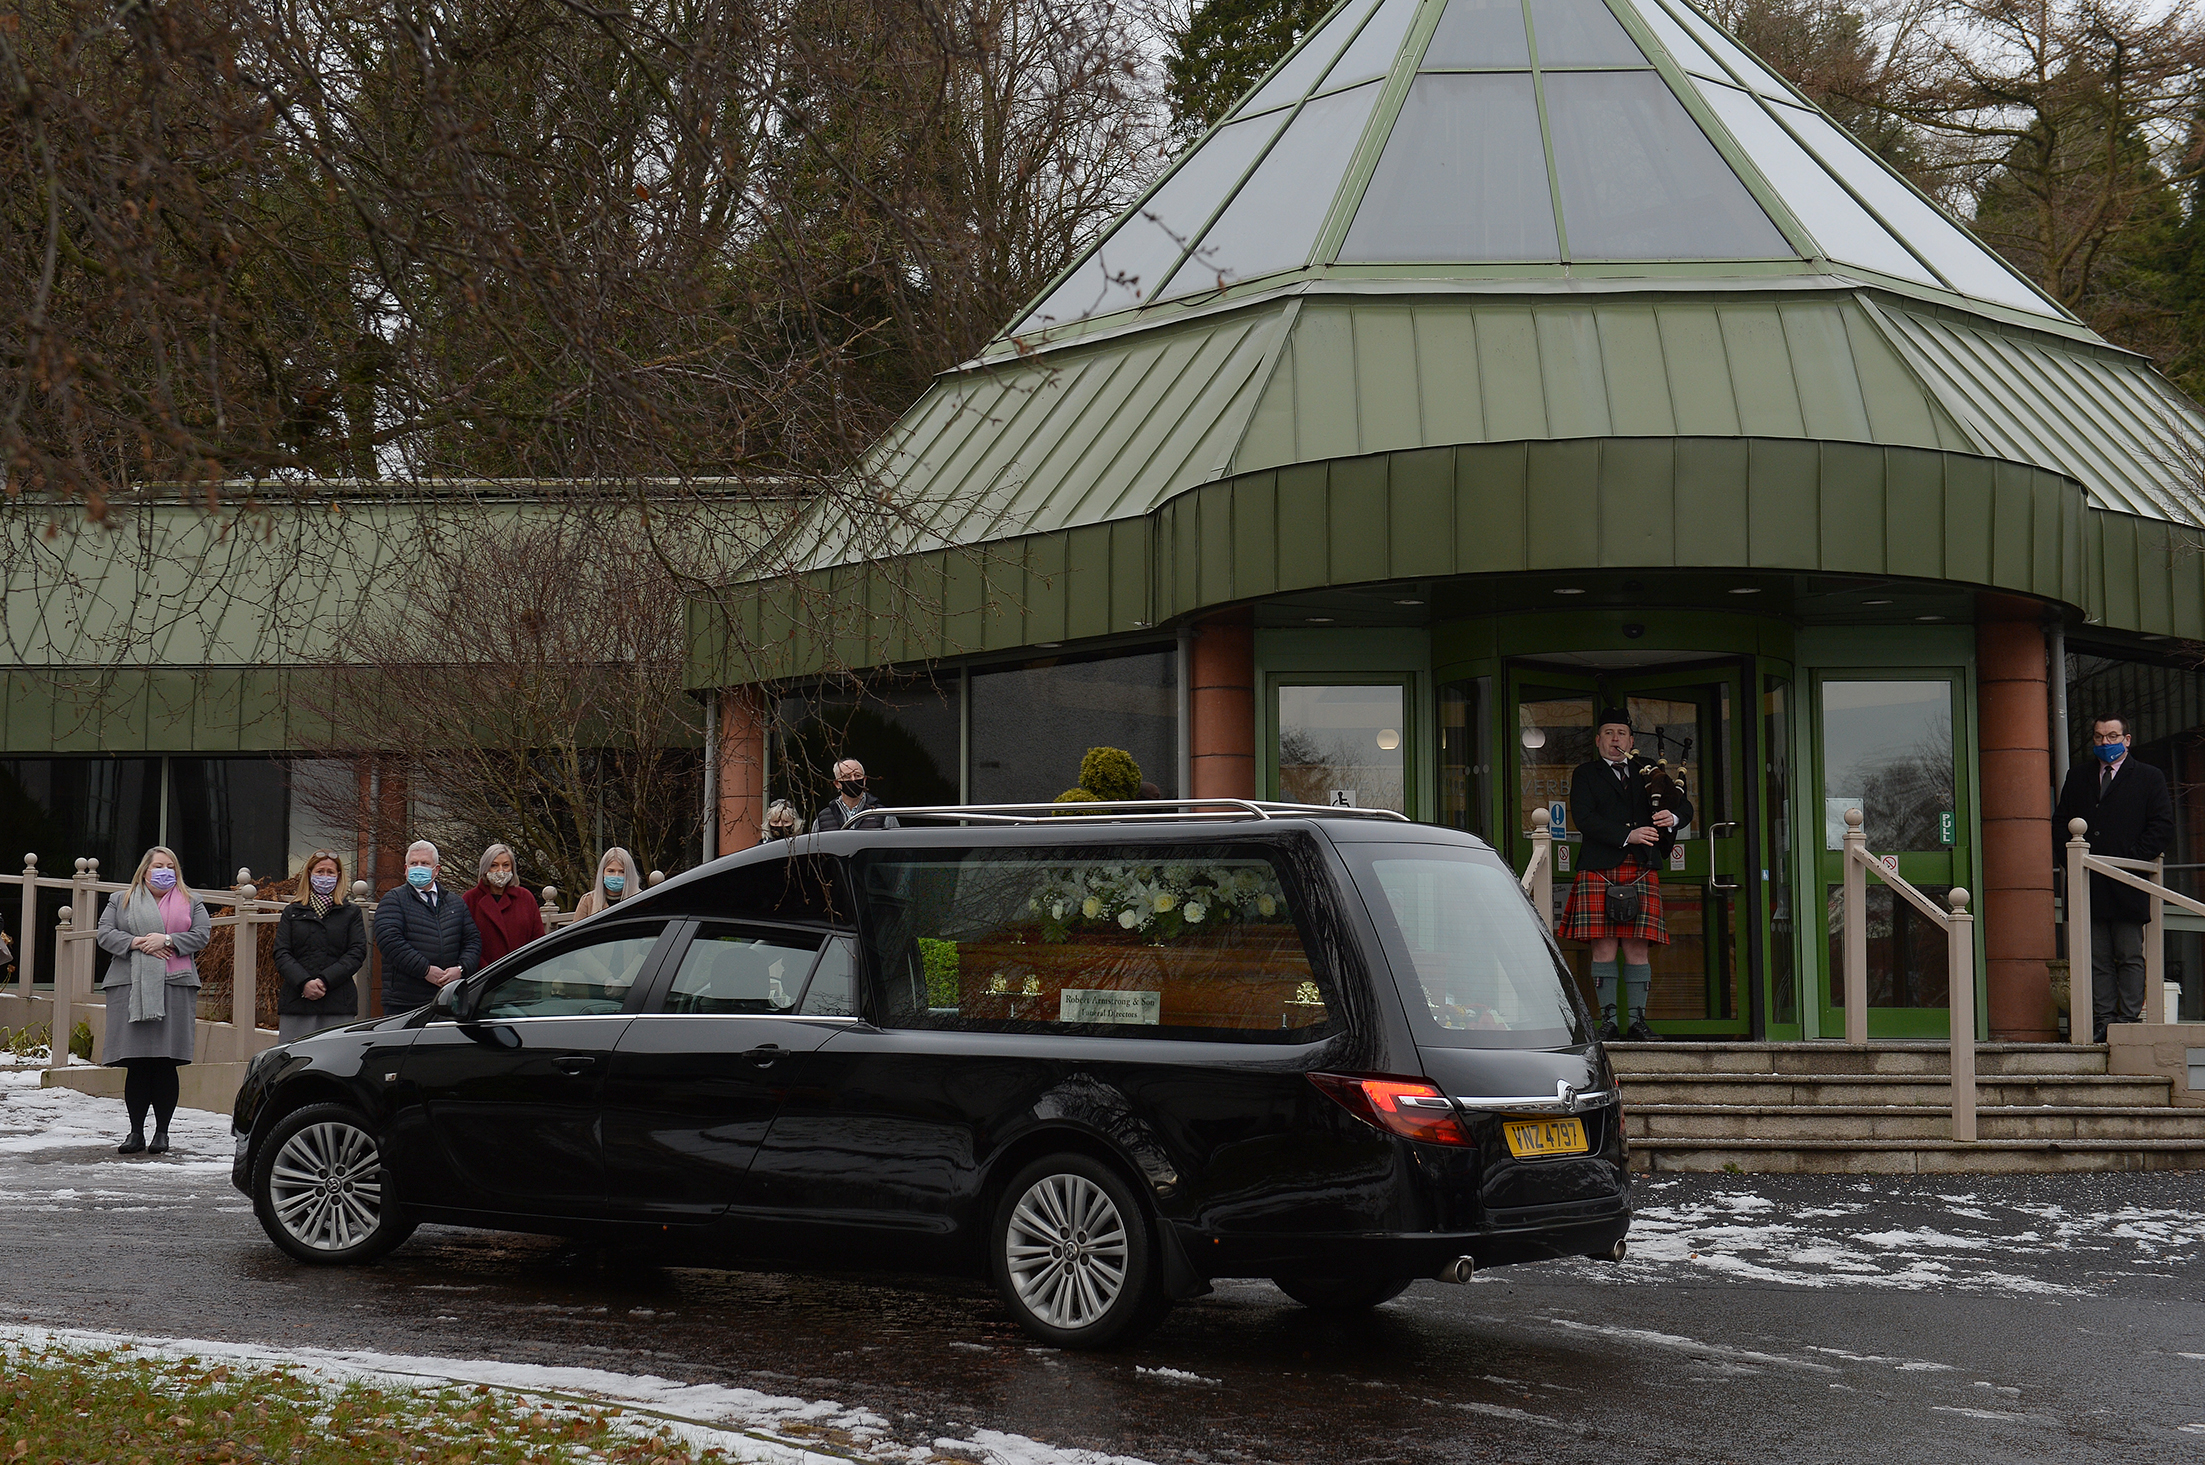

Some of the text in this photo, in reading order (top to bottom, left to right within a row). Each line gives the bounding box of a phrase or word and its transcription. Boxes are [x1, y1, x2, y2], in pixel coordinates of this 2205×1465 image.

[1942, 813, 1951, 842] PULL
[1065, 995, 1155, 1007] Robert Armstrong & Son
[1107, 1009, 1138, 1018] Directors
[1511, 1122, 1577, 1150] VNZ 4797
